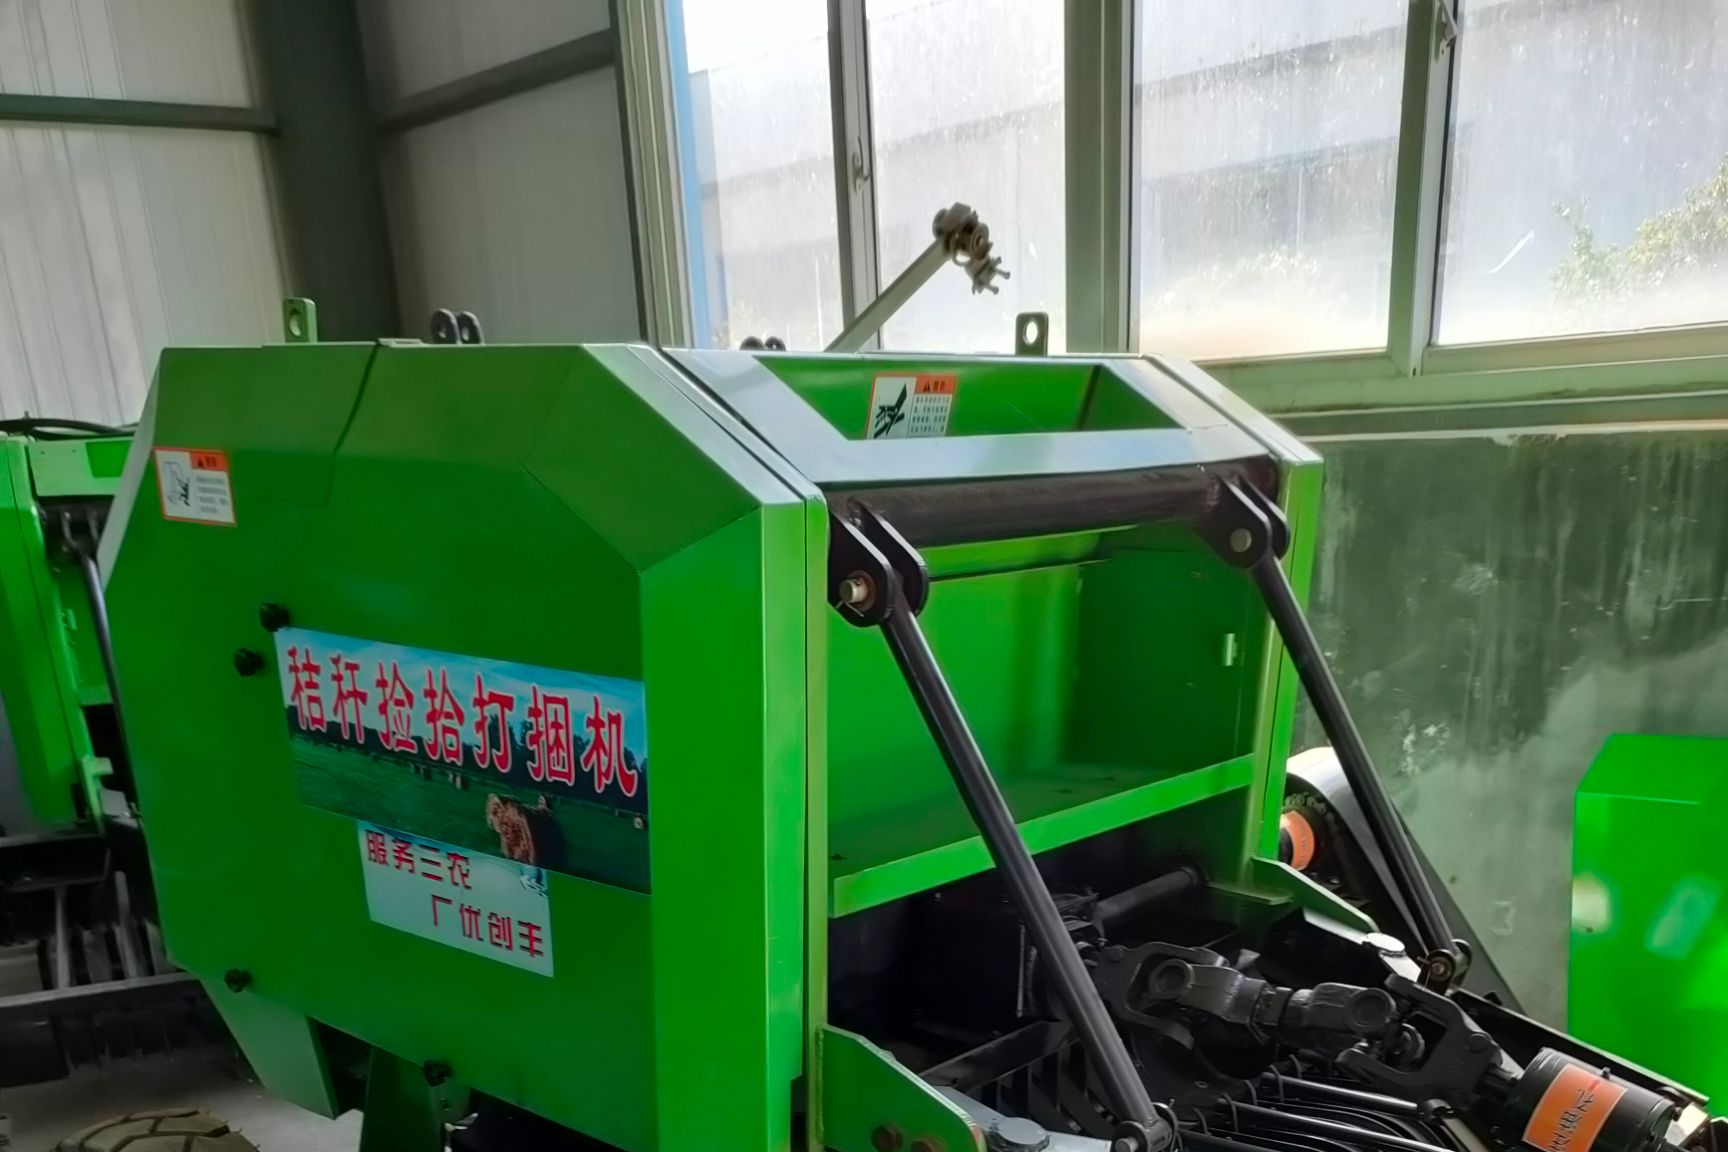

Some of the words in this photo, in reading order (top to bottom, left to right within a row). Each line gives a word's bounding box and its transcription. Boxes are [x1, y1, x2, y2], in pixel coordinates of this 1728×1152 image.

[287, 645, 639, 797] 秸秆捡拾打捆机
[366, 829, 472, 889] 服务三农
